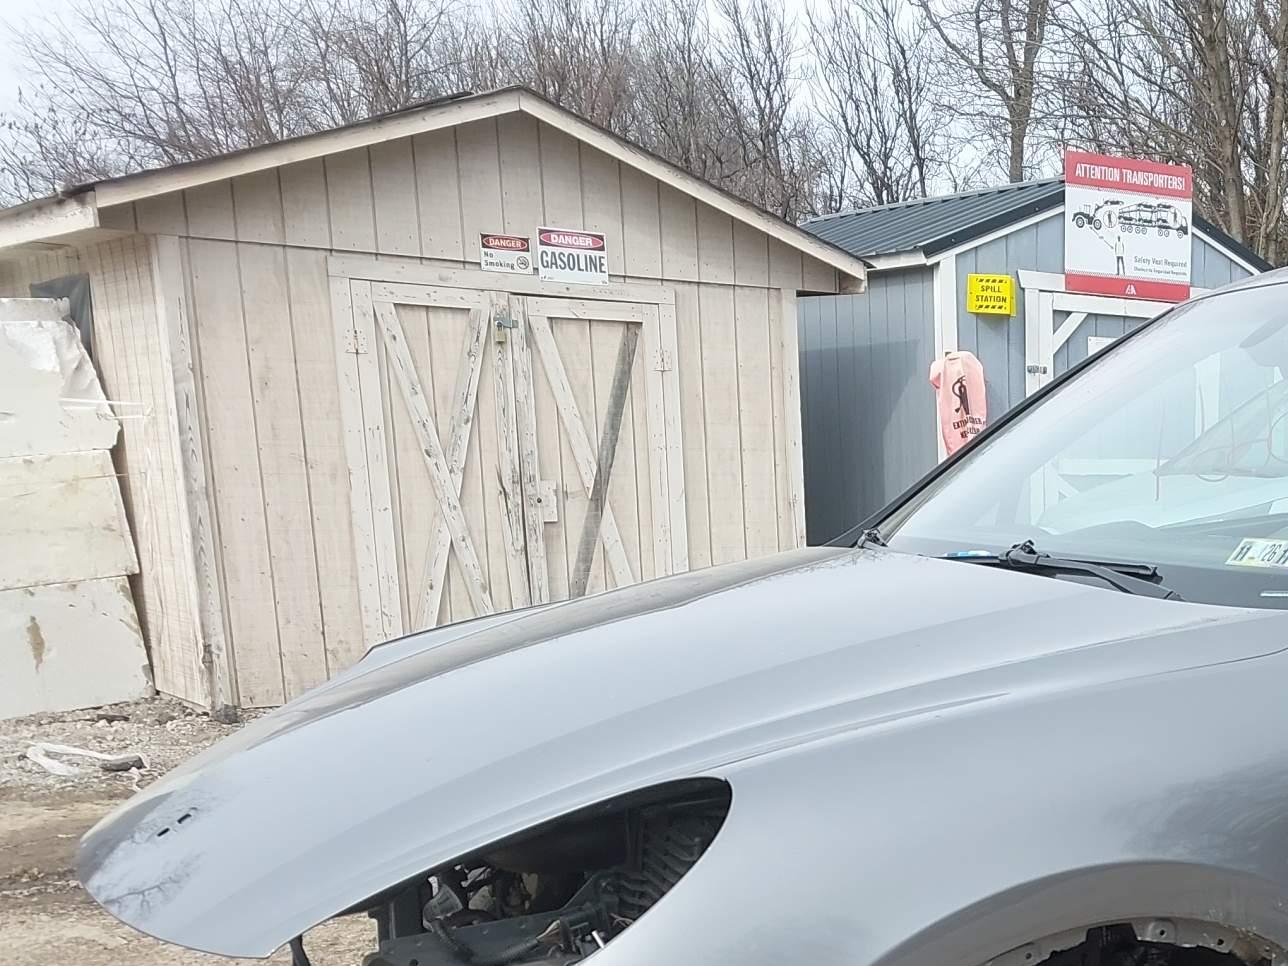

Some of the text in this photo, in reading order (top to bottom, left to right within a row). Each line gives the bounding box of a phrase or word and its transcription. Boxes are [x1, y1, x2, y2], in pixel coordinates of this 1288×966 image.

[1075, 163, 1185, 191] ATTENTION TRANSPORTERS!
[488, 238, 521, 248] DANGER
[550, 234, 593, 246] DANGER
[484, 251, 493, 259] No
[484, 259, 515, 270] Smoking
[540, 250, 606, 273] GASOLINE
[981, 285, 1002, 293] SPILL
[975, 295, 1007, 304] STATION
[1233, 544, 1253, 562] 11
